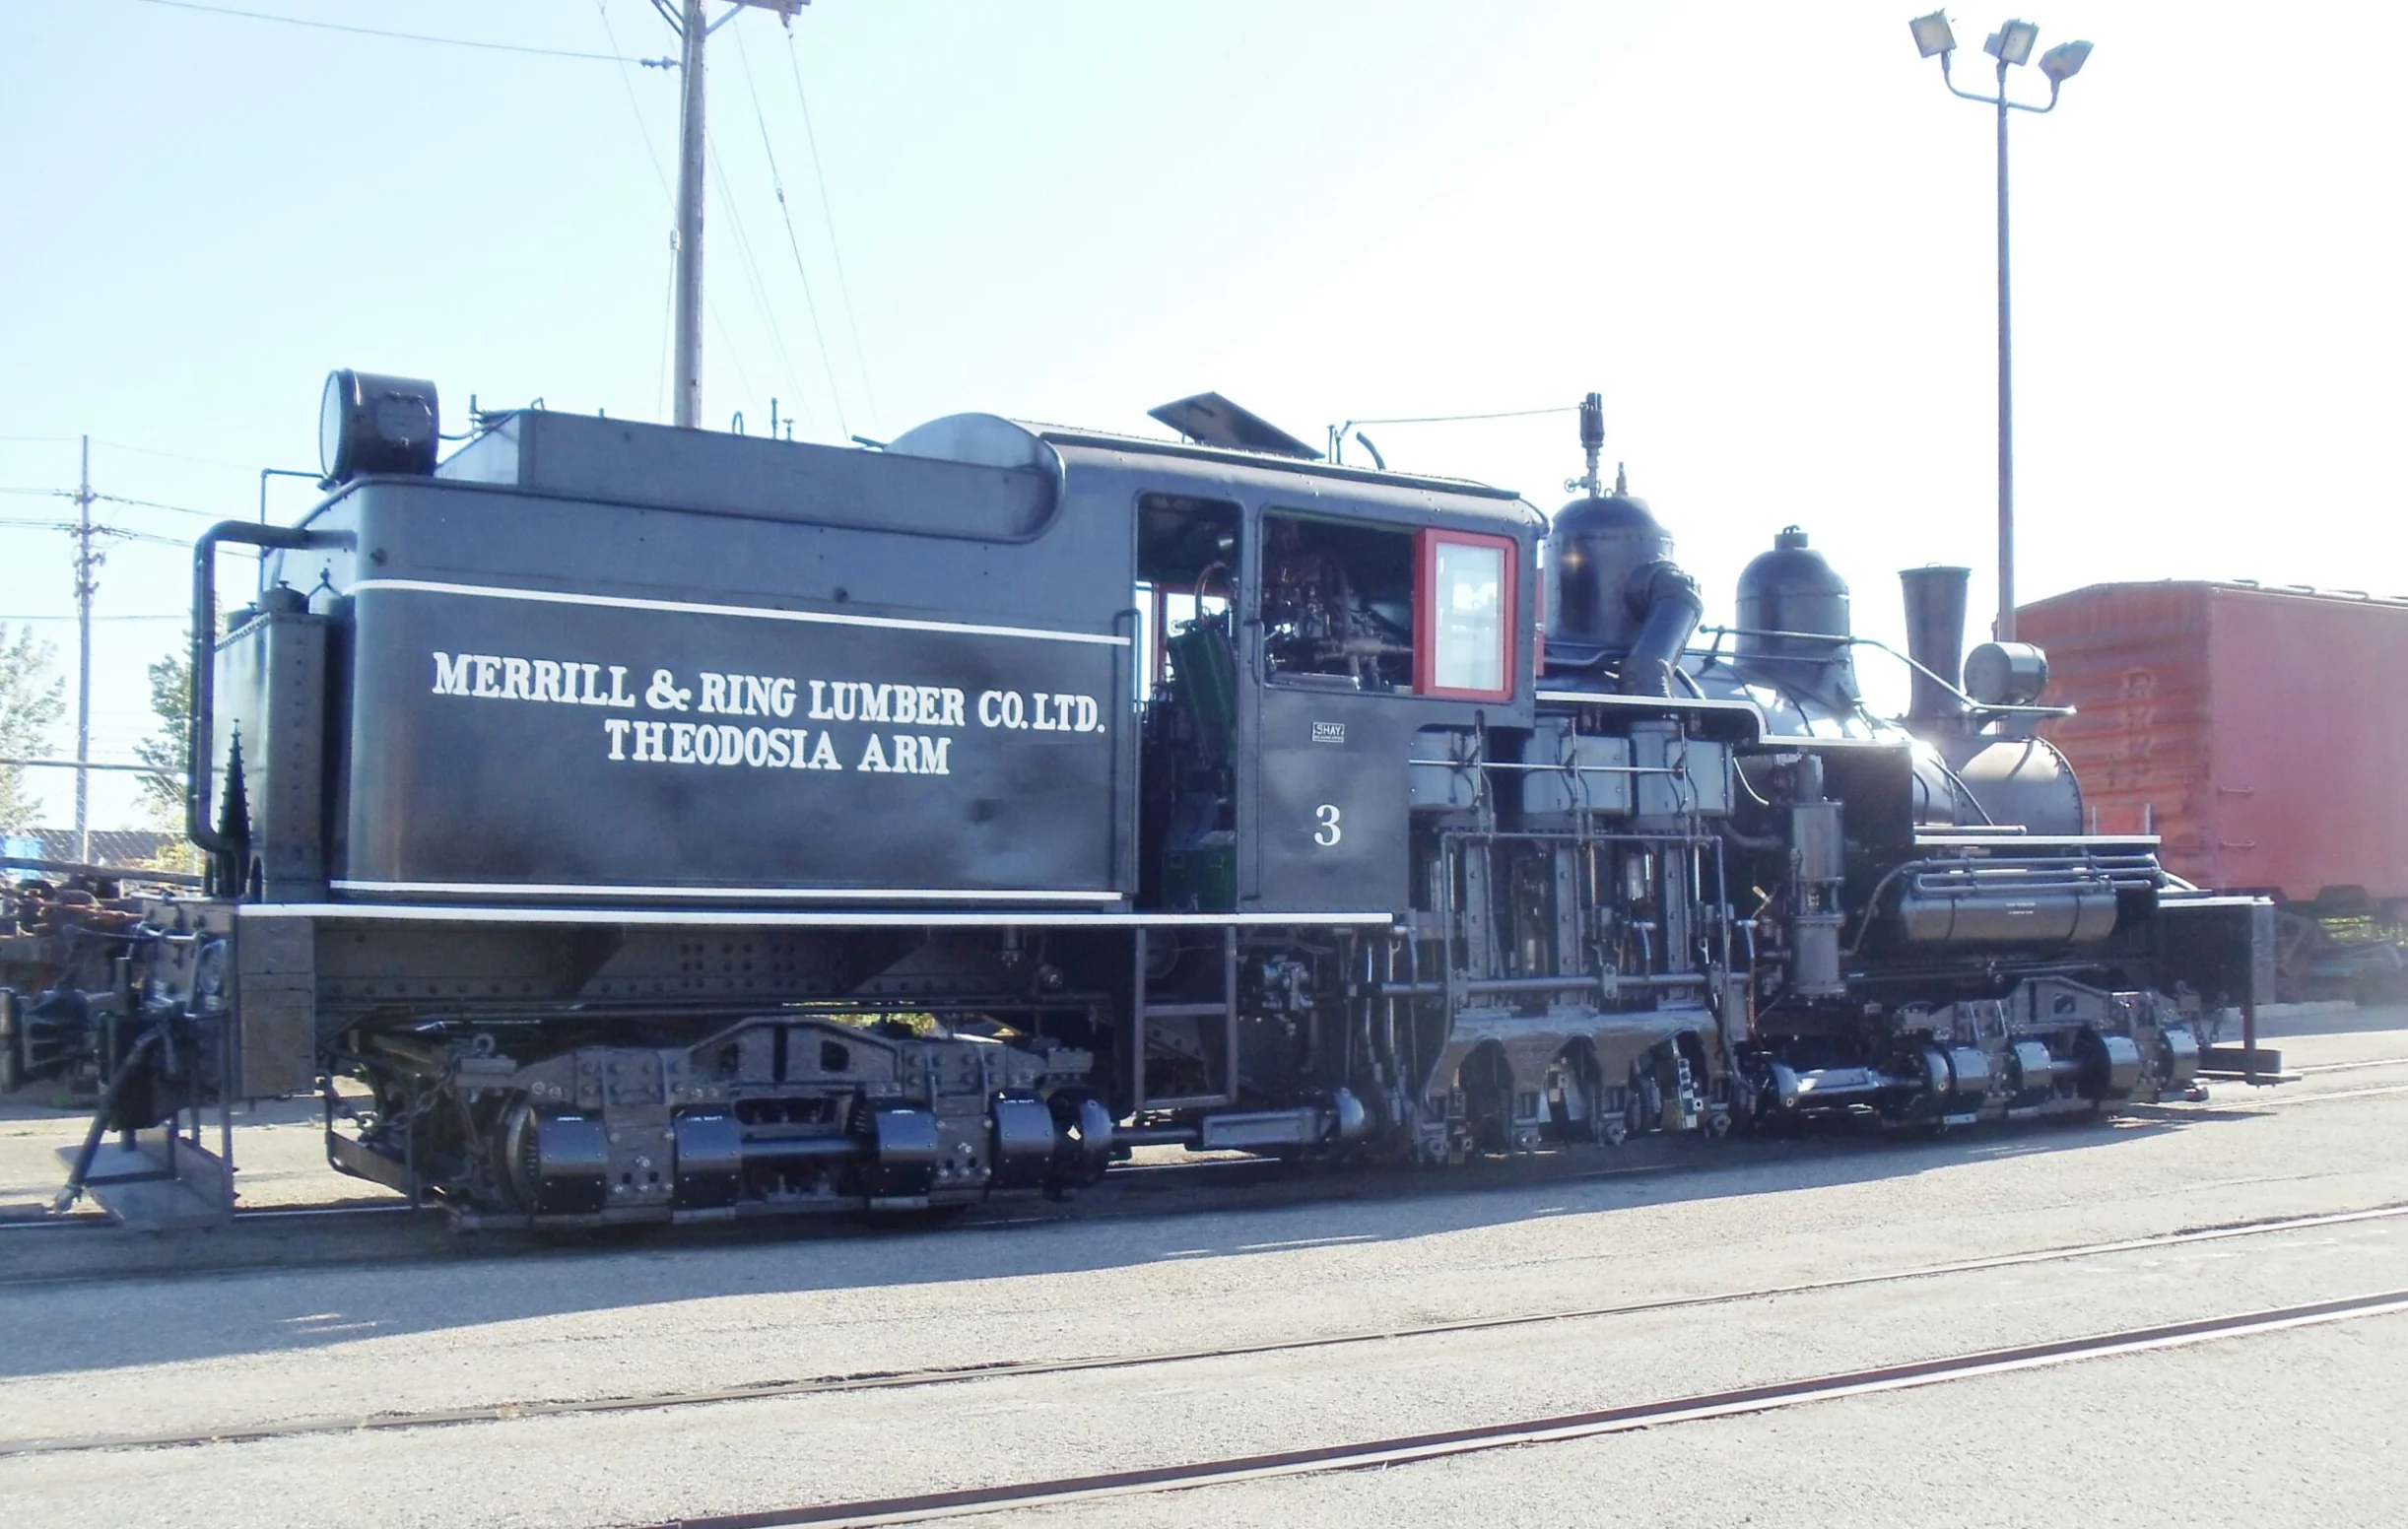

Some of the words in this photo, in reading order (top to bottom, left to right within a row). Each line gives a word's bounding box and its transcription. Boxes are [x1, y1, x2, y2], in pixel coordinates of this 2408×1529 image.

[431, 651, 636, 708] MERRILL
[644, 668, 692, 712] &
[697, 672, 797, 718] RING
[807, 680, 966, 727] LUMBER
[604, 718, 842, 770] THEODOSIA
[856, 733, 952, 775] ARM
[1316, 724, 1341, 736] SHAY
[1313, 804, 1342, 847] 3
